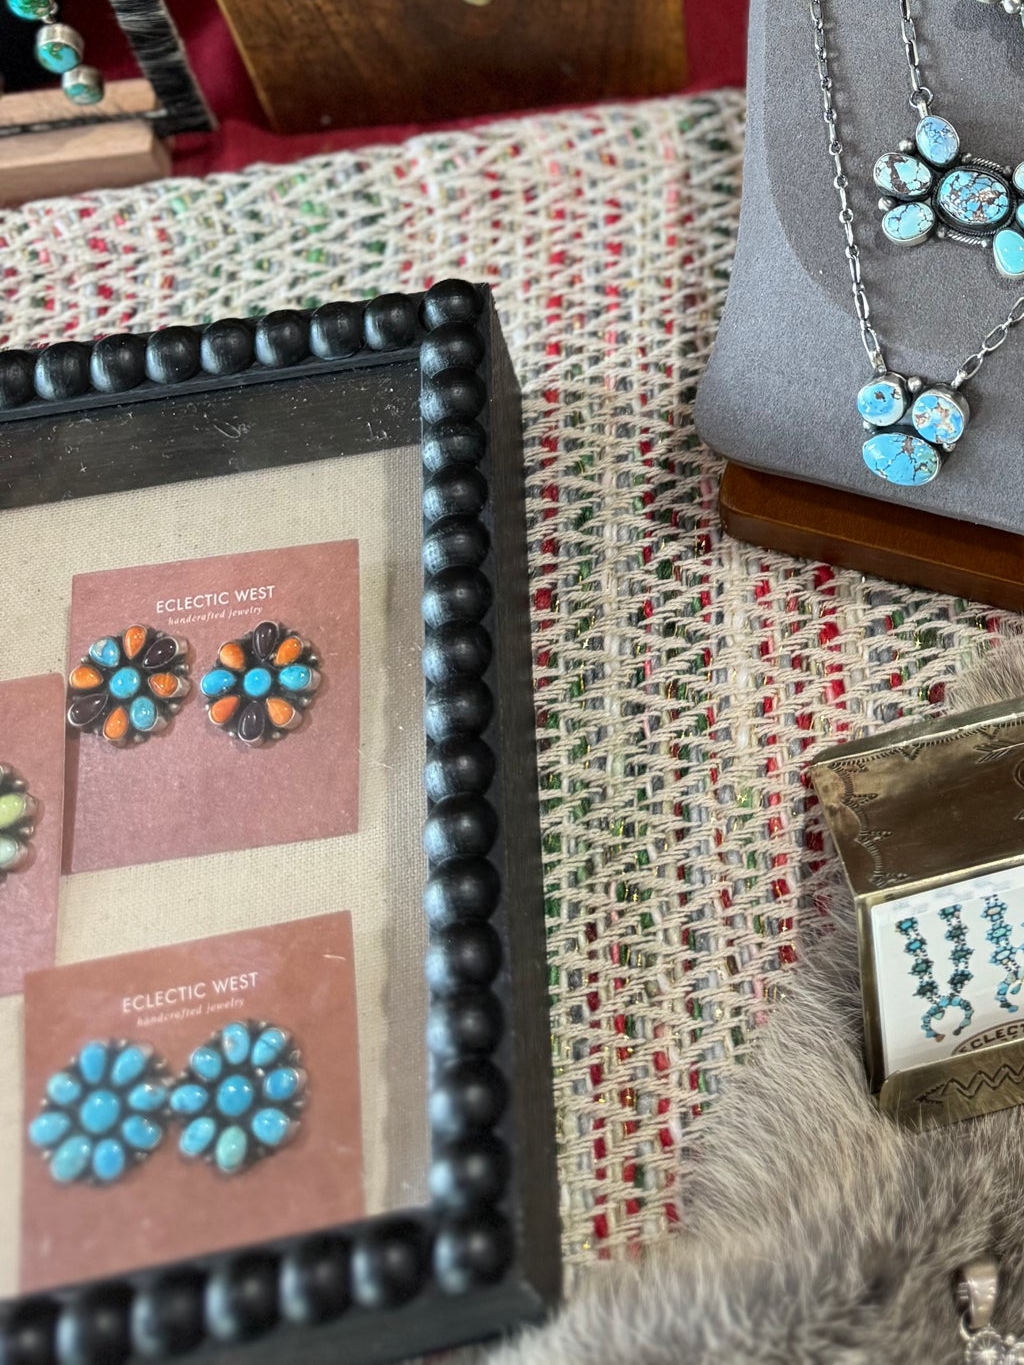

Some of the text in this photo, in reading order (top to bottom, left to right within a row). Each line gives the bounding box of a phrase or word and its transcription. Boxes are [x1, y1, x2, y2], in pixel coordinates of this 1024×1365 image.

[155, 585, 276, 614] ECLECTIC WEST
[167, 605, 263, 626] handcrafted jewelry
[122, 971, 259, 1013] ECLECTIC WEST
[136, 997, 246, 1027] handcrafted jewelry
